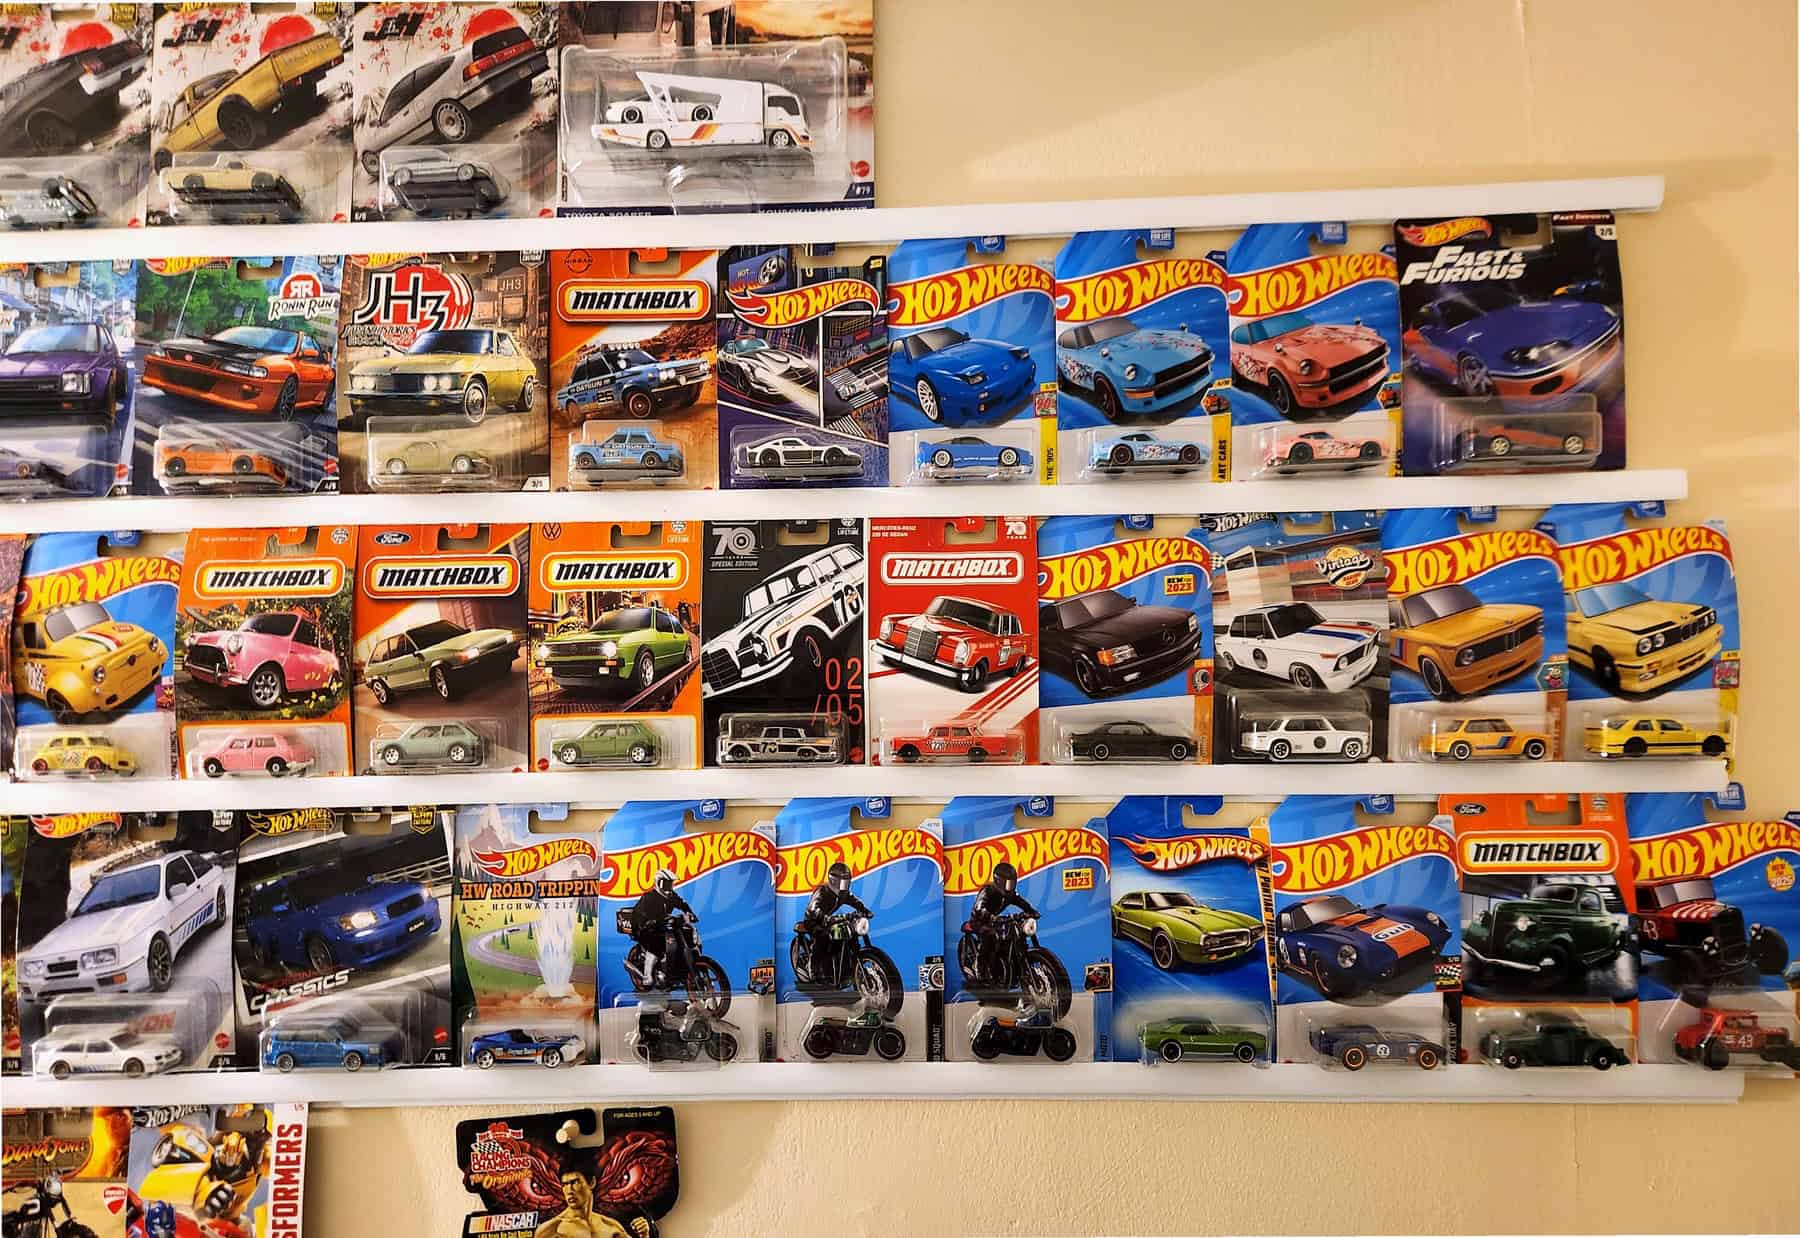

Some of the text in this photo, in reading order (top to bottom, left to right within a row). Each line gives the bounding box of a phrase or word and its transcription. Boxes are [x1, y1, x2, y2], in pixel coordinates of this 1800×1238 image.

[1423, 222, 1447, 245] HOT
[1432, 245, 1525, 268] FAST &
[1240, 253, 1397, 316] HOT WHEELS
[1400, 262, 1527, 286] FURIOUS
[571, 289, 695, 310] MATCHBOX
[898, 263, 1051, 322] HOT WHEELS
[1067, 258, 1224, 321] HOT WHEELS
[268, 298, 337, 319] RONIN RUN
[766, 284, 872, 326] HOT WHEELS
[1217, 440, 1228, 481] ART CARS
[1046, 466, 1055, 481] THE
[1215, 516, 1239, 532] HOT
[381, 533, 404, 543] Ford
[711, 526, 756, 557] 70
[711, 558, 758, 567] SPECIAL EDITION
[891, 559, 1013, 577] MATCHBOX
[1048, 537, 1204, 599] HOT WHEELS
[1315, 554, 1368, 574] Vintage
[1396, 529, 1558, 593] HOT WHEELS
[1562, 525, 1725, 590] HOT WHEELS
[208, 568, 332, 588] MATCHBOX
[377, 565, 505, 587] MATCHBOX
[554, 561, 675, 581] MATCHBOX
[25, 556, 181, 615] HOT WHEELS
[1167, 583, 1193, 593] 2023
[824, 657, 863, 690] 02
[811, 693, 863, 727] /05
[53, 815, 77, 835] HOT
[271, 814, 297, 834] HOT
[502, 839, 593, 876] HOT WHEELS
[947, 829, 1102, 893] HOT WHEELS
[1157, 836, 1263, 870] HOT WHEELS
[1286, 825, 1450, 891] HOT WHEELS
[1473, 842, 1602, 862] MATCHBOX
[1630, 821, 1800, 881] HOT WHEELS
[610, 832, 770, 897] HOT WHEELS
[784, 829, 937, 895] HOT WHEELS
[1065, 871, 1081, 879] NEW
[1065, 877, 1091, 889] 2023
[461, 880, 600, 899] HW ROAD TRIPPIN
[492, 903, 549, 911] HIGHWAY
[1642, 920, 1659, 940] 43
[1737, 1034, 1753, 1047] 43
[147, 1107, 171, 1126] HOT
[471, 1151, 511, 1162] RACING
[472, 1158, 531, 1172] CHAMPIONS
[491, 1212, 538, 1231] NASCAR
